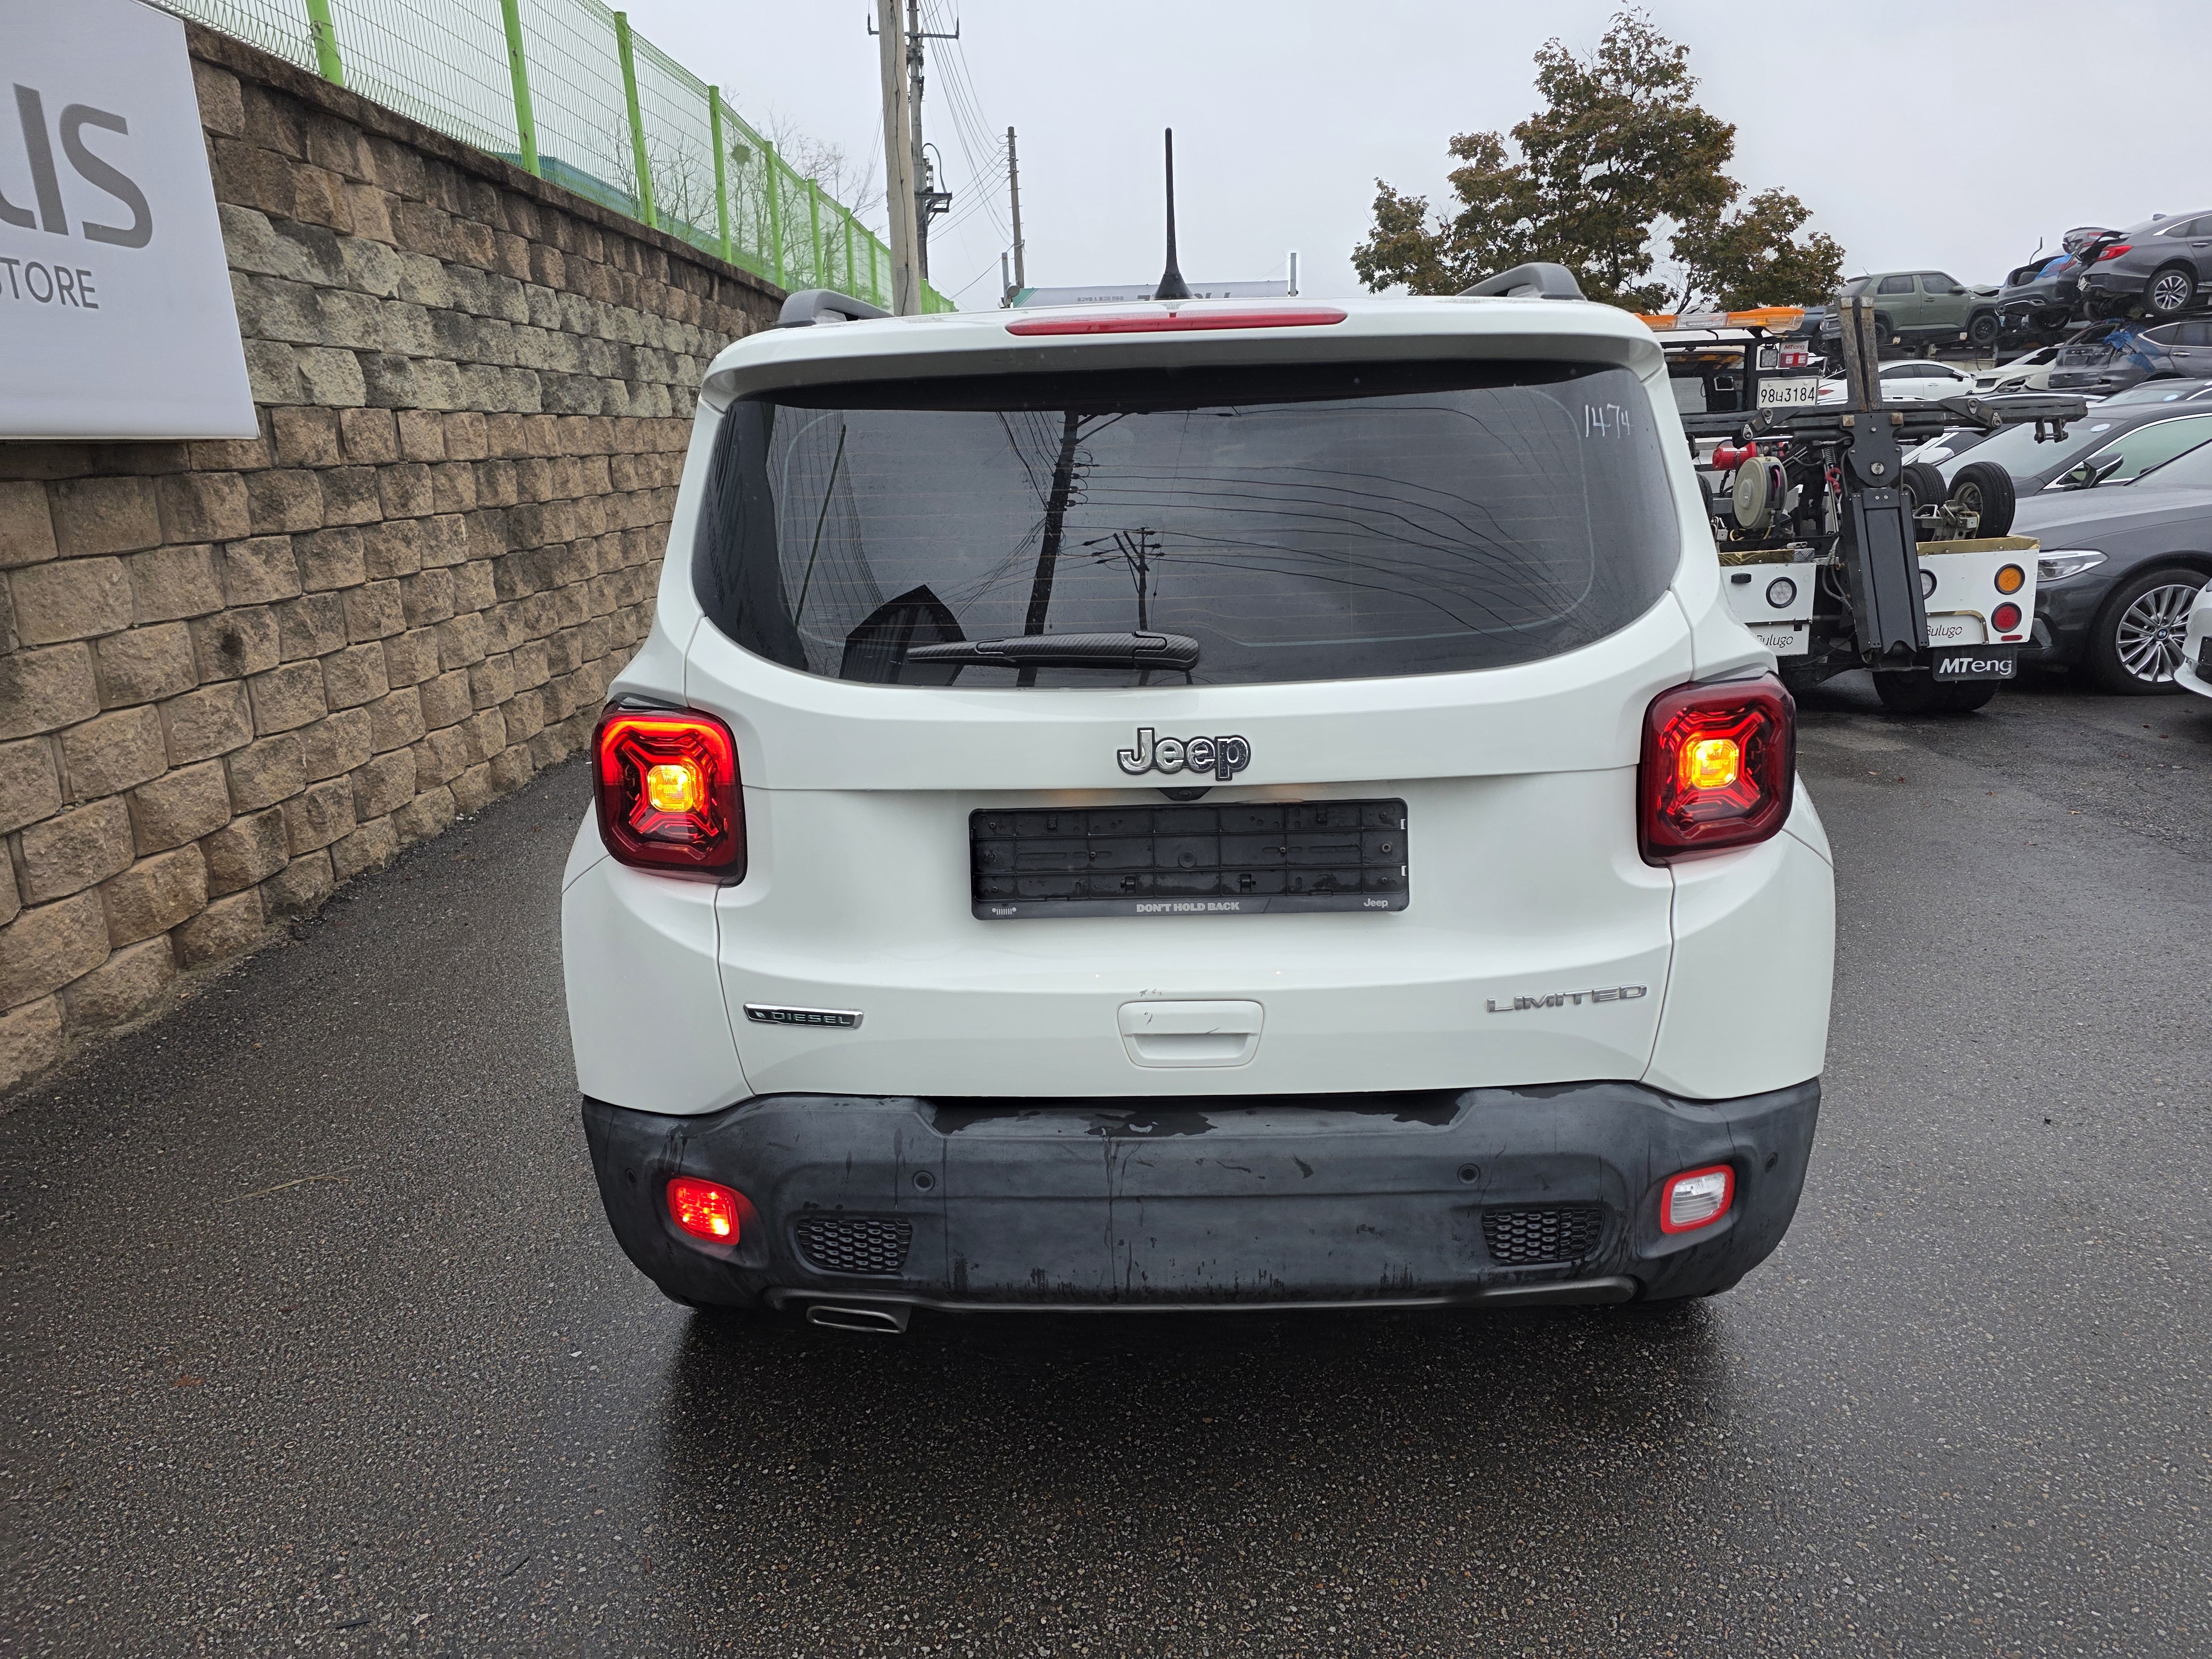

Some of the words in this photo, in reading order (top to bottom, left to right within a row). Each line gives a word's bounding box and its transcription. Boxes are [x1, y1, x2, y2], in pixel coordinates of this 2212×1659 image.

[0, 257, 99, 309] TORE
[1761, 387, 1815, 403] 98너3184
[1585, 403, 1634, 439] 1474
[1939, 658, 2012, 675] MTeng
[1117, 727, 1251, 781] Jeep
[1136, 903, 1172, 912] DON'T
[1173, 902, 1206, 911] HOLD
[1207, 902, 1240, 911] BACK
[1363, 898, 1389, 908] Jeep
[1486, 983, 1647, 1013] LIMITED
[771, 1011, 851, 1024] DIESEL
